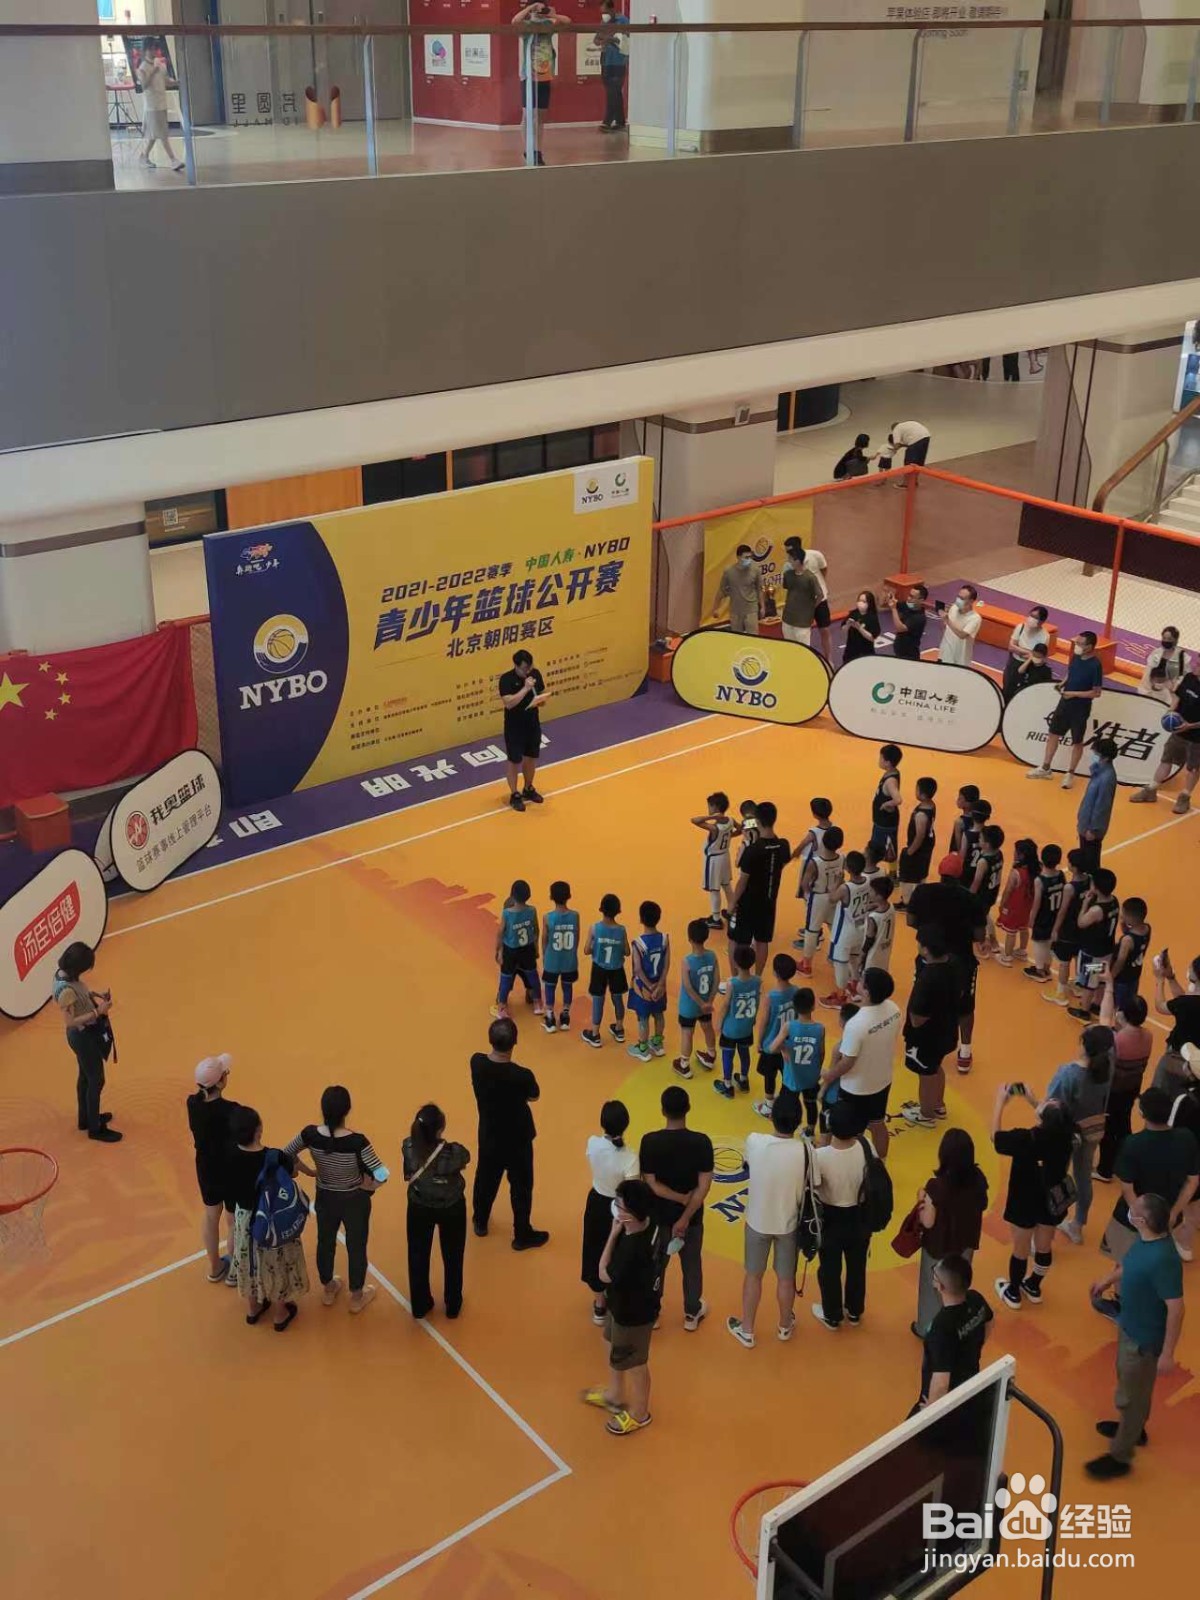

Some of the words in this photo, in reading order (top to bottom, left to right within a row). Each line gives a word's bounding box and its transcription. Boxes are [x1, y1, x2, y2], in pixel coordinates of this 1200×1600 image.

[374, 560, 624, 651] 青少年篮球公开赛
[447, 616, 554, 658] 北京朝阳赛区
[239, 670, 327, 710] NYBO
[716, 685, 777, 708] NYBO
[900, 686, 959, 706] 中国人寿
[898, 699, 930, 709] CHINA
[934, 704, 957, 713] LIFE
[518, 928, 529, 946] 3
[553, 932, 574, 951] 30
[604, 946, 613, 964] 1
[650, 953, 661, 976] 7
[699, 974, 709, 995] 8
[735, 997, 756, 1018] 23
[793, 1044, 814, 1064] 12
